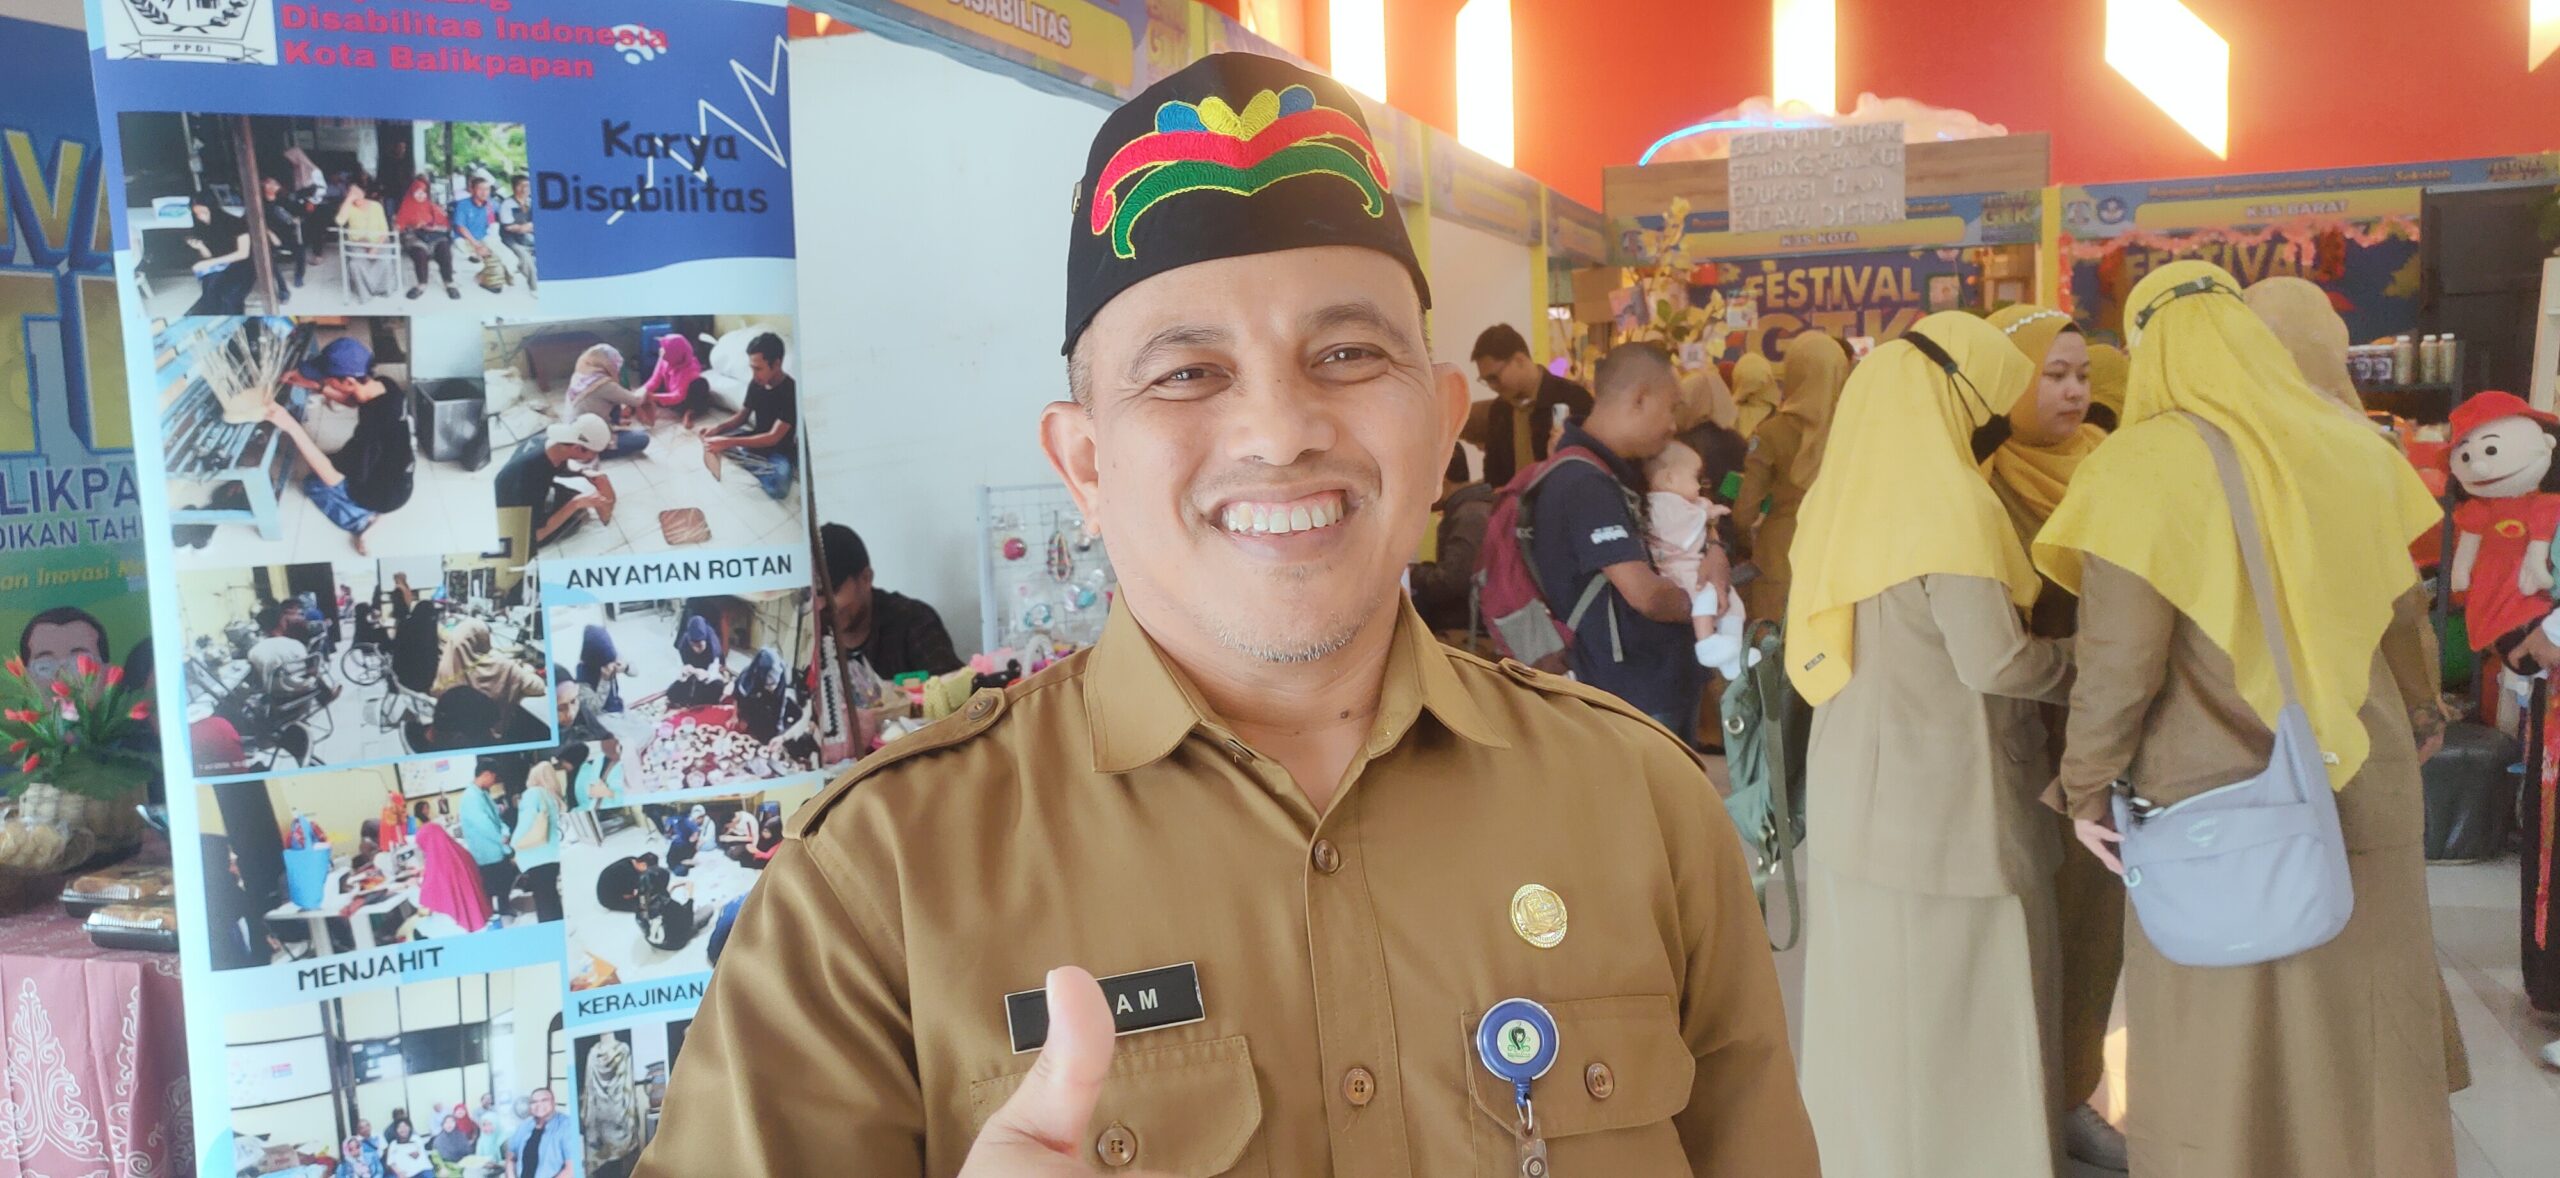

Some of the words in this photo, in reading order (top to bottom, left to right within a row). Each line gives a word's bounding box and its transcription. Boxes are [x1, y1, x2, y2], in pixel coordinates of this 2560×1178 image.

[281, 5, 483, 39] Disabilitas
[495, 16, 668, 48] Indonesia
[949, 0, 1072, 48] ABILITAS
[283, 40, 377, 69] Kota
[389, 45, 595, 80] Balikpapan
[601, 118, 739, 173] Karya
[537, 171, 769, 214] Disabilitas
[1818, 230, 1859, 245] KOTA
[1746, 265, 1921, 310] FESTIVAL
[86, 515, 143, 541] TAH
[566, 560, 701, 590] ANYAMAN
[709, 554, 793, 580] ROTAN
[298, 946, 445, 991] MENJAHIT
[577, 981, 704, 1018] KERAJINAN
[1116, 988, 1159, 1015] AM
